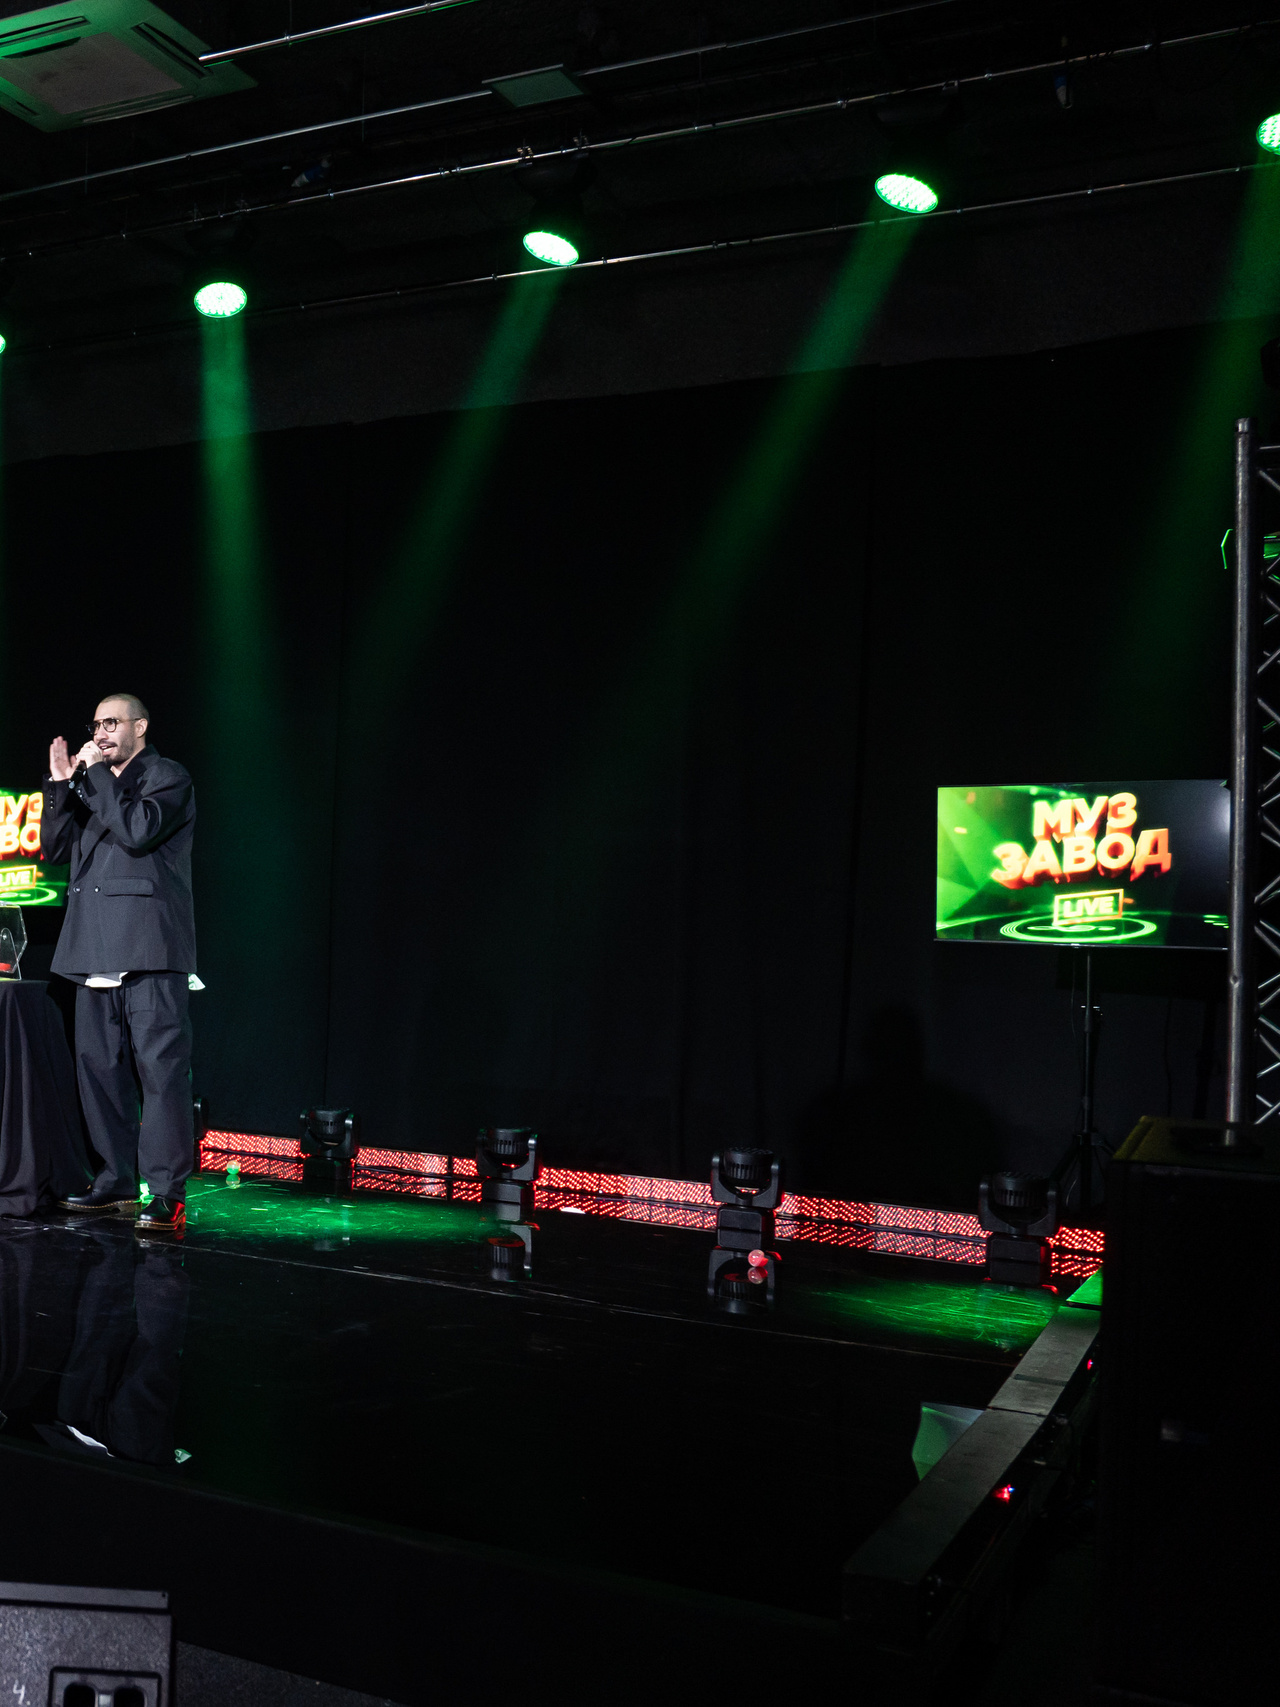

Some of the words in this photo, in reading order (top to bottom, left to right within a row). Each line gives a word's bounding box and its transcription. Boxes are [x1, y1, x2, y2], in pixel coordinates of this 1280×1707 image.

[1033, 792, 1138, 838] МУЗ
[990, 828, 1171, 888] ЗАВОД
[1063, 896, 1115, 918] LIVE
